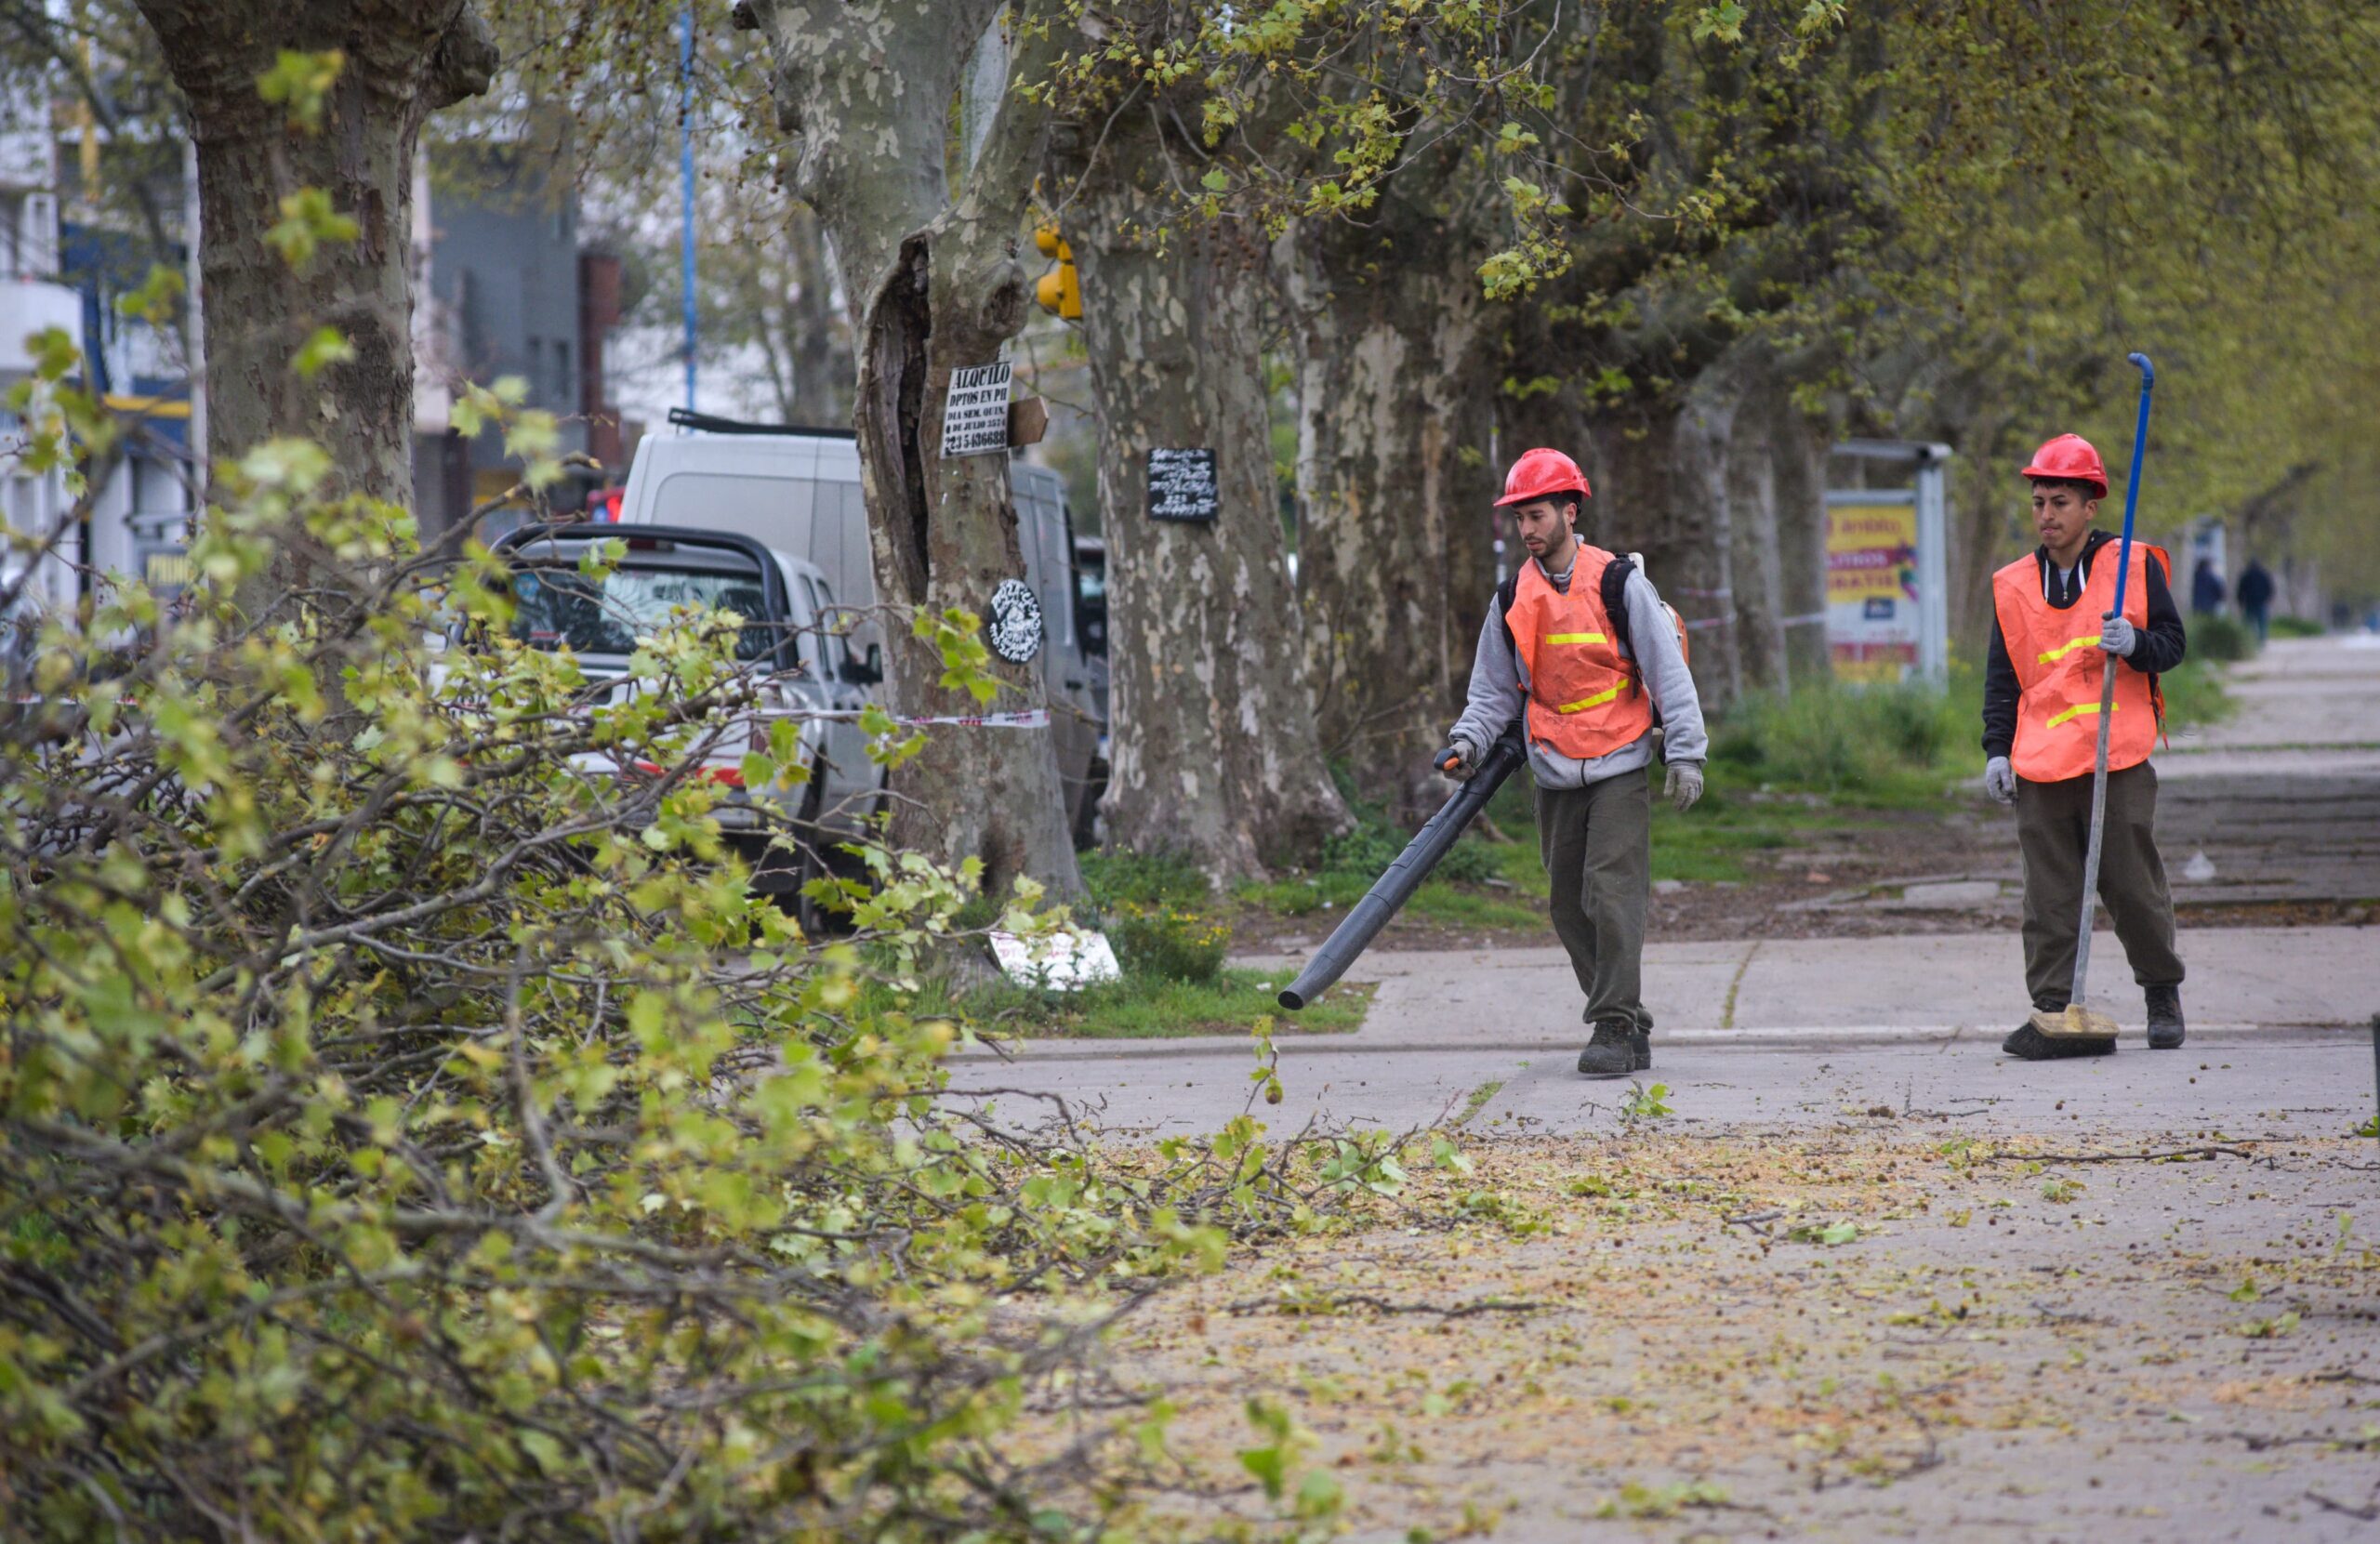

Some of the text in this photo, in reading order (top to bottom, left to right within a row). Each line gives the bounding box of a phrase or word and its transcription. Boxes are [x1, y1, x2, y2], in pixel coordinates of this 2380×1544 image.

[952, 364, 1011, 389] ALQUILO
[949, 388, 1008, 407] DPTOS EN PH
[947, 411, 961, 421] DIA
[953, 423, 961, 431] DE
[963, 421, 985, 430] JULIO
